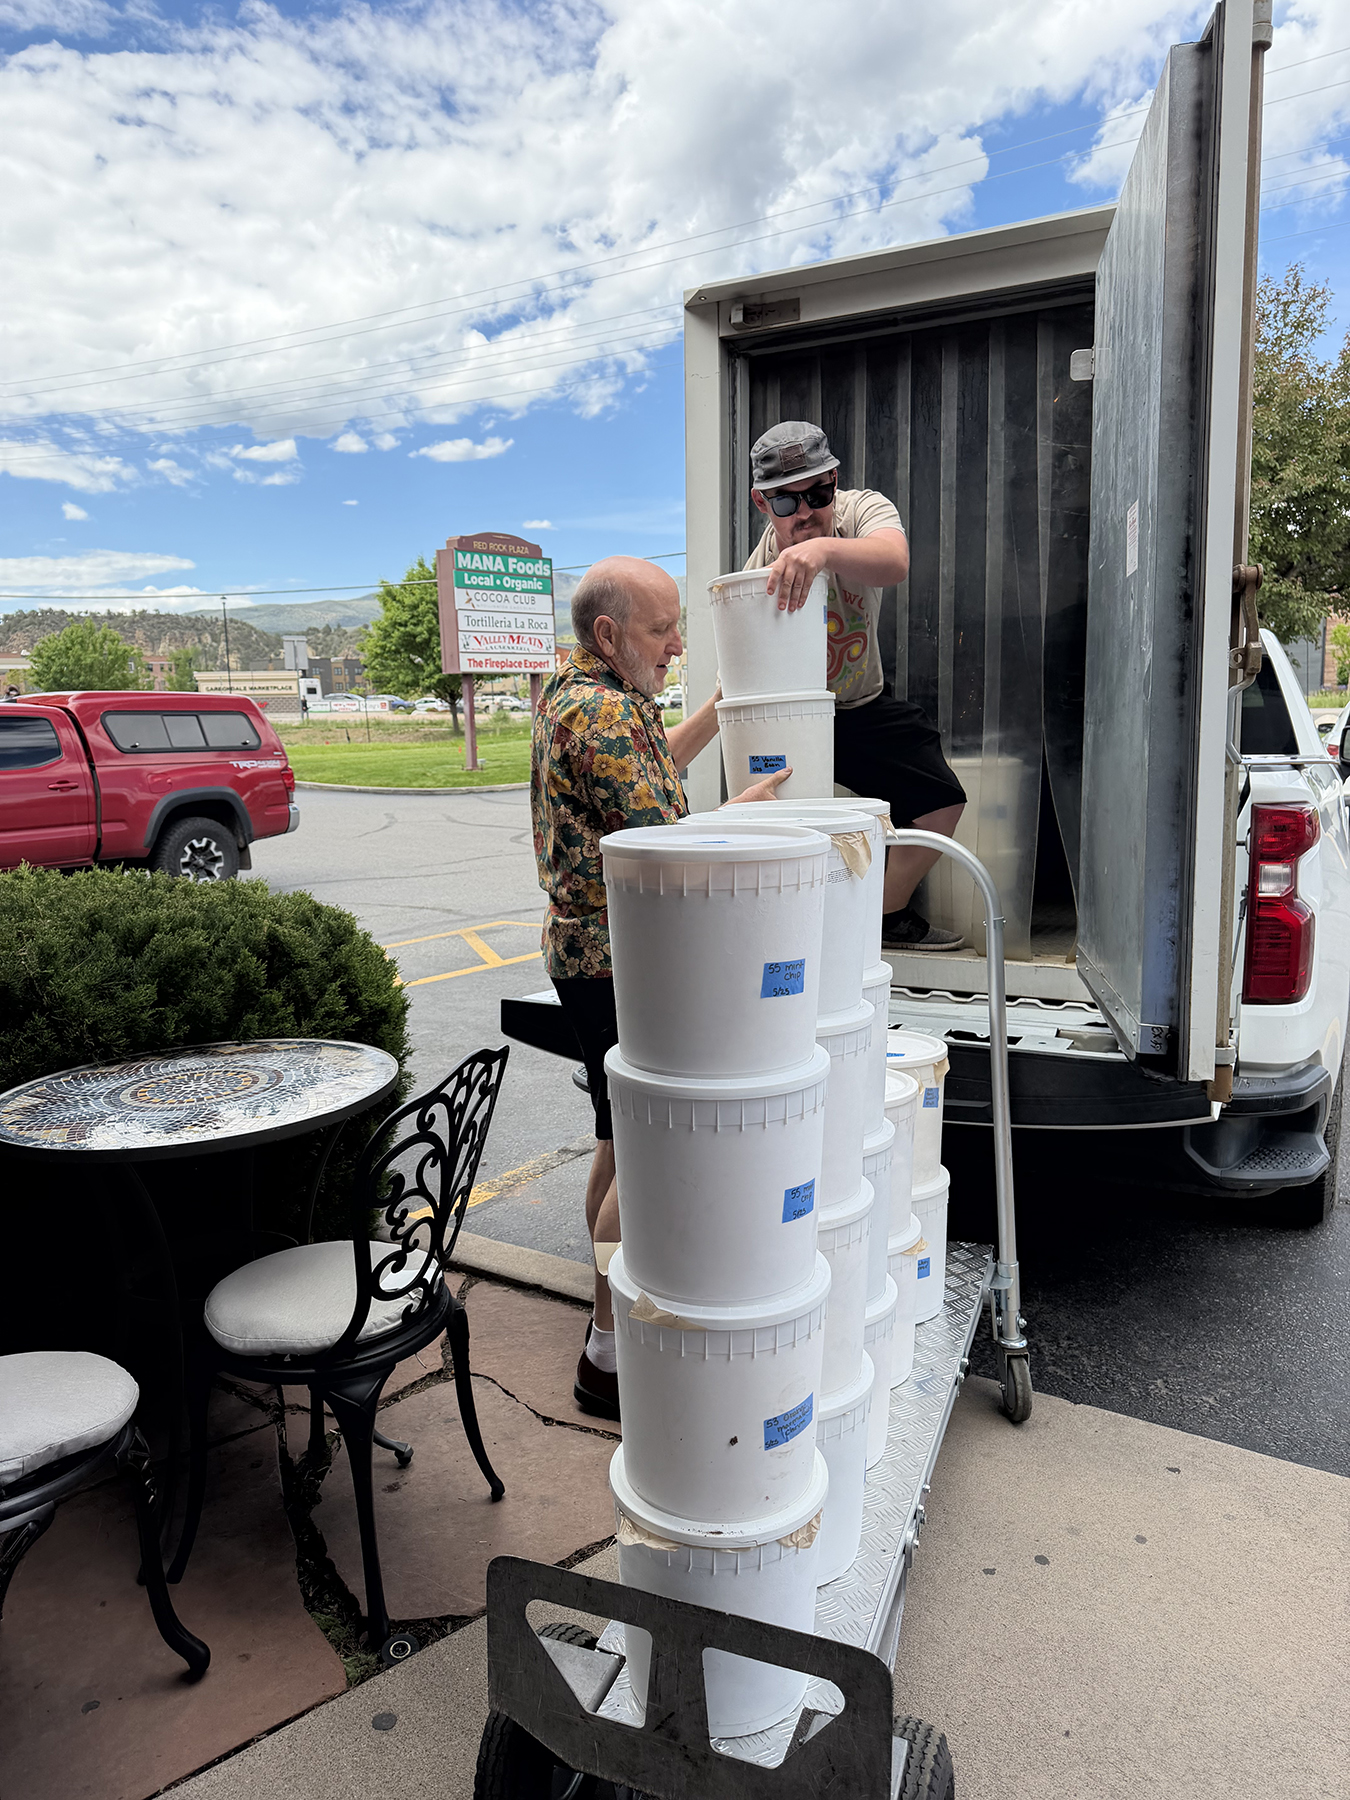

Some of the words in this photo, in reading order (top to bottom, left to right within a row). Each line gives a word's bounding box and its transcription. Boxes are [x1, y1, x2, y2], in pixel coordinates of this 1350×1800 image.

[473, 541, 487, 550] RED
[489, 542, 507, 552] ROCK
[509, 545, 530, 555] PLAZA
[457, 552, 505, 573] MANA
[508, 557, 550, 576] Foods
[464, 572, 493, 586] Local
[503, 577, 543, 591] Organic
[474, 592, 510, 604] COCOA
[513, 595, 536, 605] CLUB
[464, 615, 512, 629] Tortilleria
[514, 618, 525, 629] La
[528, 619, 548, 630] Roca
[467, 658, 483, 668] The
[484, 658, 522, 670] Fireplace
[523, 659, 550, 670] Expert
